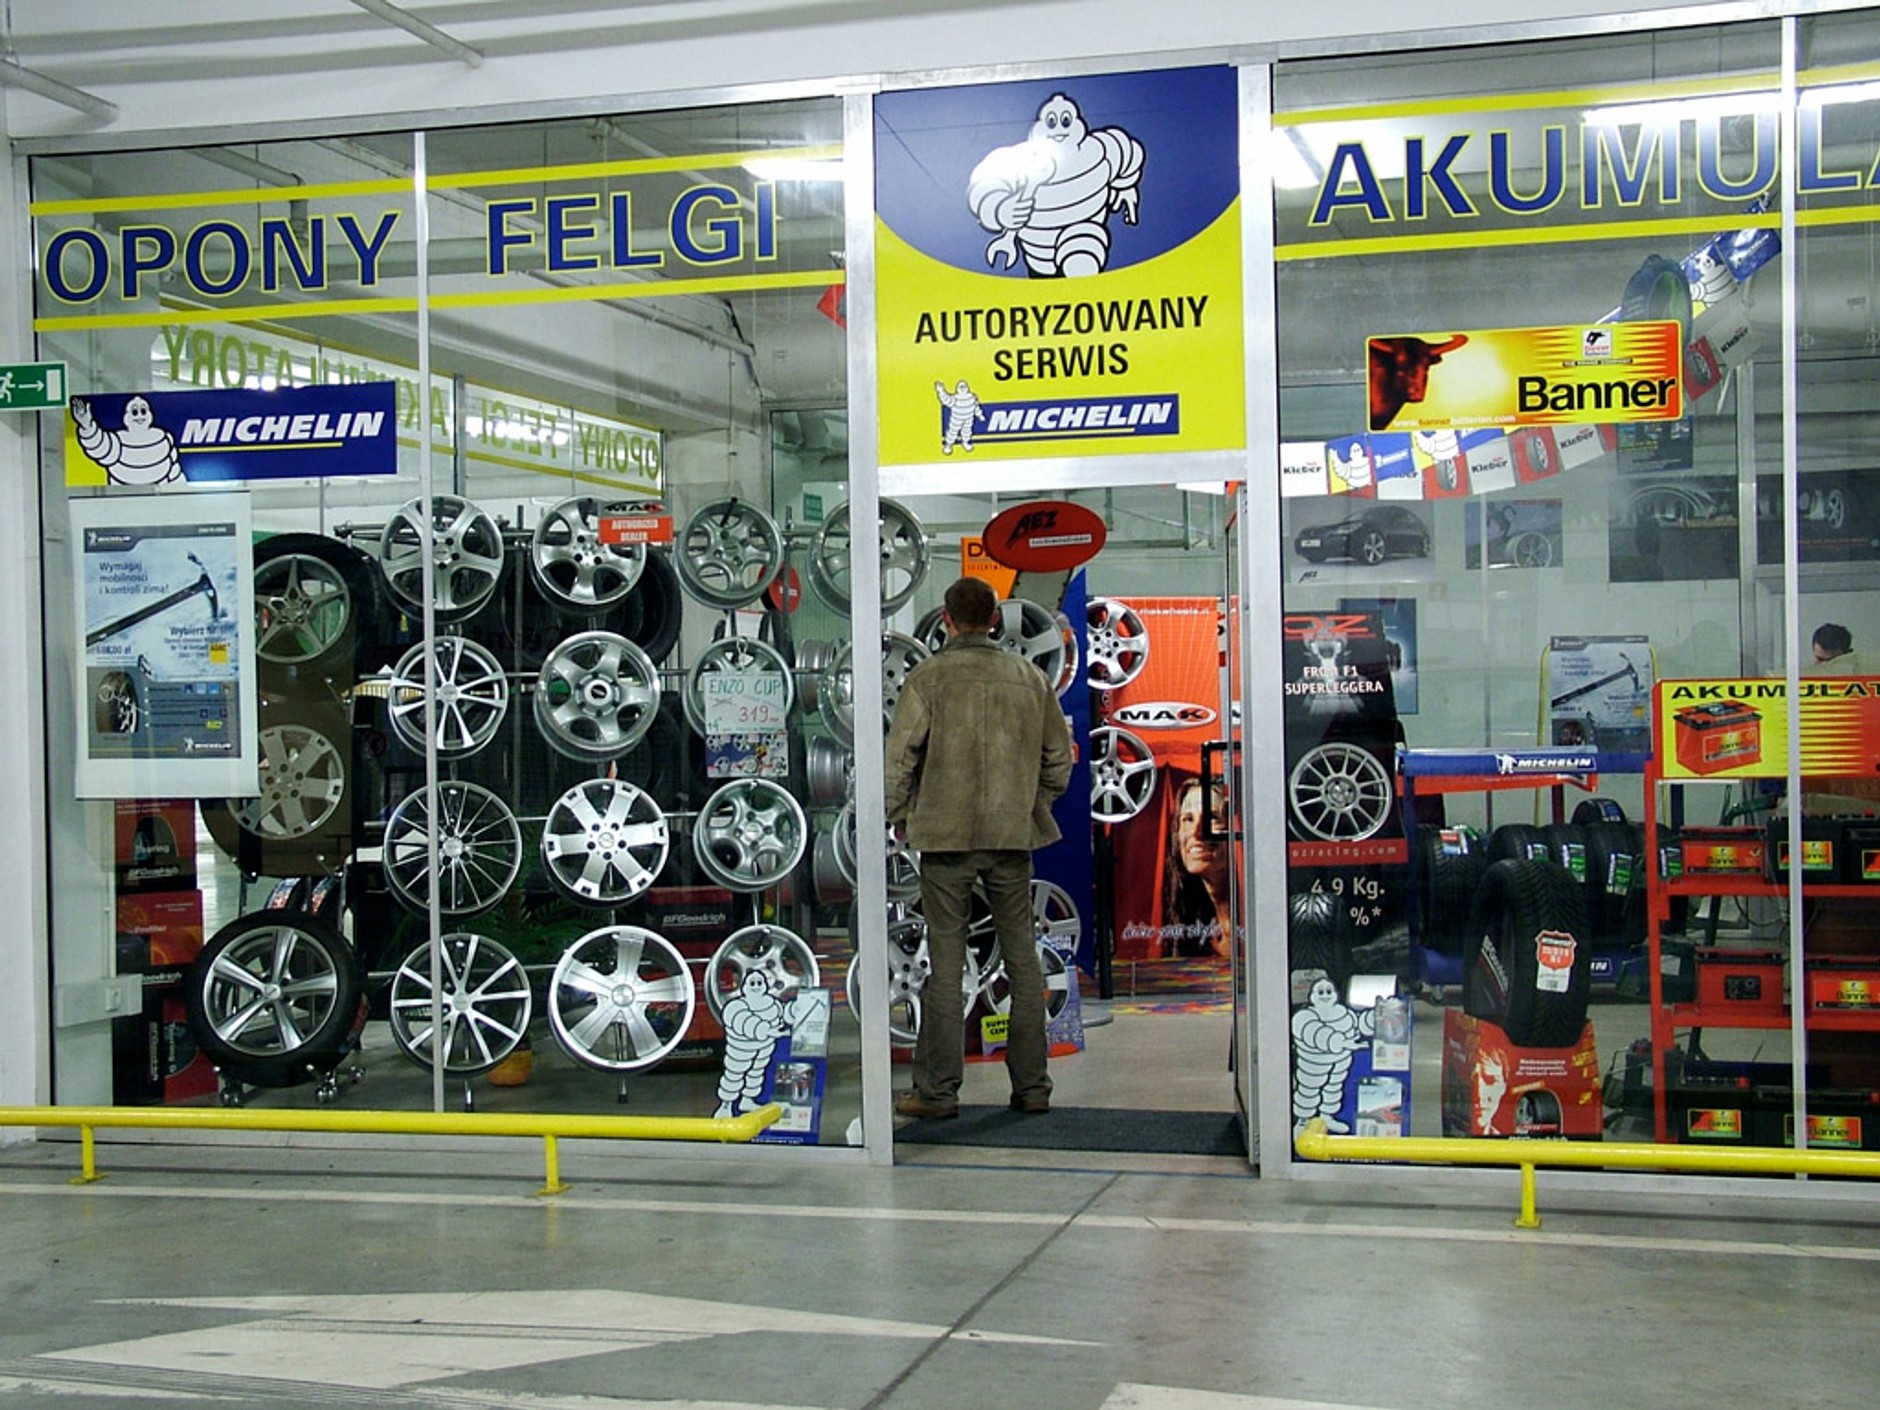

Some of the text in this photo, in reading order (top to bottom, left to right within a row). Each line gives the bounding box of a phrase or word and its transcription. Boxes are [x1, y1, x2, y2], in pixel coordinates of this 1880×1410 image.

[1307, 103, 1880, 227] AKUMUL
[44, 181, 778, 306] OPONY FELGI
[915, 296, 1209, 344] AUTORYZOWANY
[993, 344, 1128, 381] SERWIS
[1518, 376, 1676, 412] Banner
[181, 411, 385, 445] MICHELIN
[987, 402, 1172, 432] MICHELIN
[1283, 466, 1321, 475] Kleber
[1006, 510, 1058, 549] AEZ
[1284, 614, 1370, 635] OZ
[1343, 664, 1359, 677] F1
[709, 679, 782, 695] ENZO CUP
[1285, 680, 1384, 695] SUPERLEGGERA
[1119, 710, 1204, 720] MAK
[1517, 758, 1592, 768] MICHELIN
[1292, 846, 1397, 858] ozracing.com
[1353, 877, 1386, 899] Kg.
